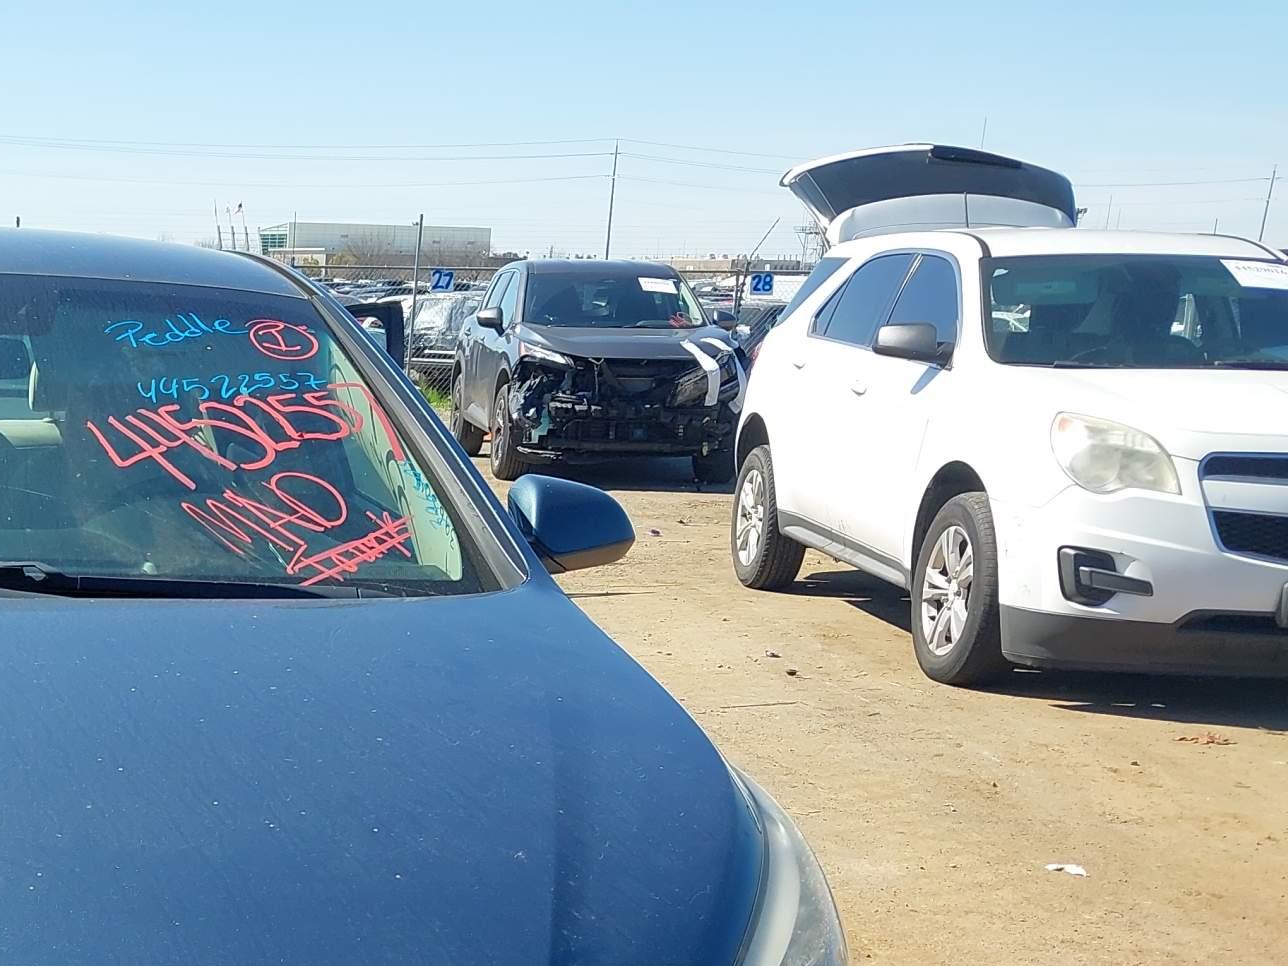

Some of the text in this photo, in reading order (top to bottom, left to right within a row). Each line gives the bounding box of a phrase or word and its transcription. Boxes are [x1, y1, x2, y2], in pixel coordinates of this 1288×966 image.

[431, 270, 454, 290] 27
[751, 273, 774, 292] 28
[103, 311, 249, 348] Peddle
[136, 371, 328, 403] 44522557
